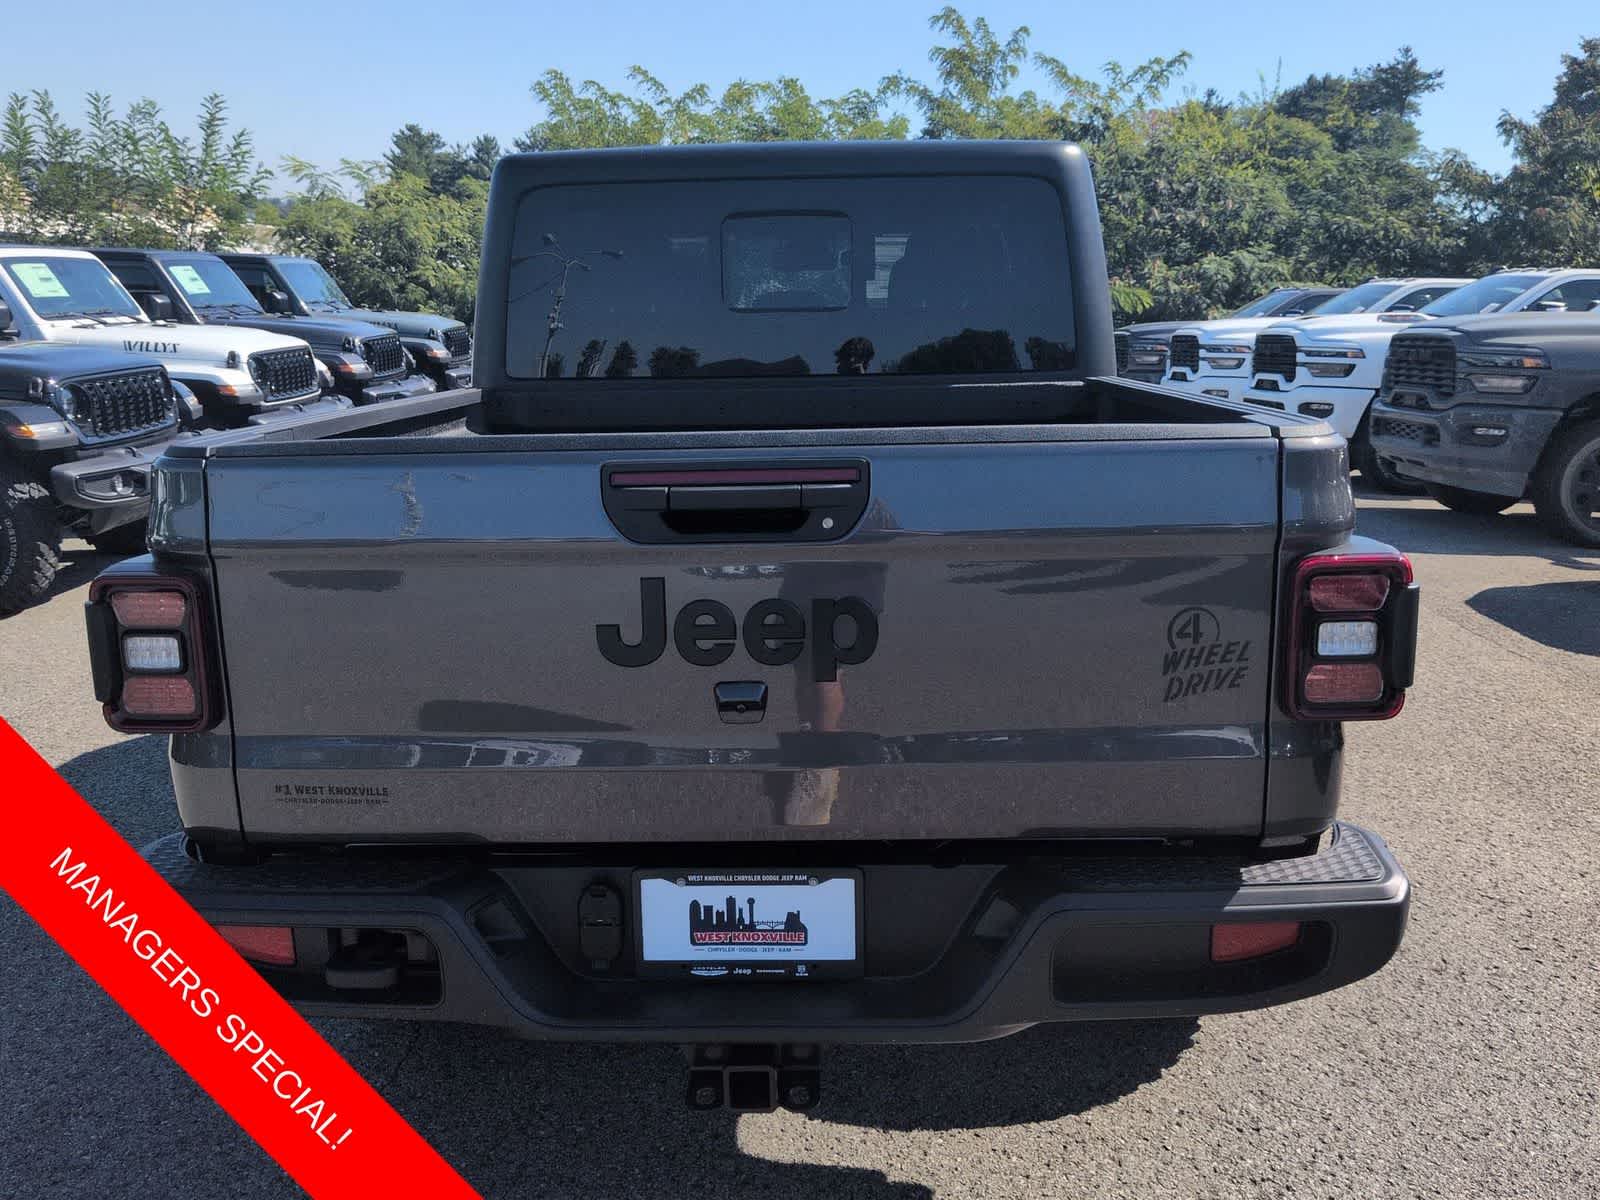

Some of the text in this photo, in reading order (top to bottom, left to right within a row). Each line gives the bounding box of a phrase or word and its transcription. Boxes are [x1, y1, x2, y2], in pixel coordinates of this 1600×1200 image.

[123, 340, 180, 352] WILLYS
[596, 577, 879, 682] Jeep
[1176, 613, 1203, 644] 4
[1162, 640, 1250, 676] WHEEL
[1163, 666, 1248, 702] DRIVE
[294, 785, 324, 796] WEST
[328, 785, 389, 797] KNOXVILLE
[694, 931, 806, 944] WEST KNOXVILLE
[733, 967, 752, 976] Jeep
